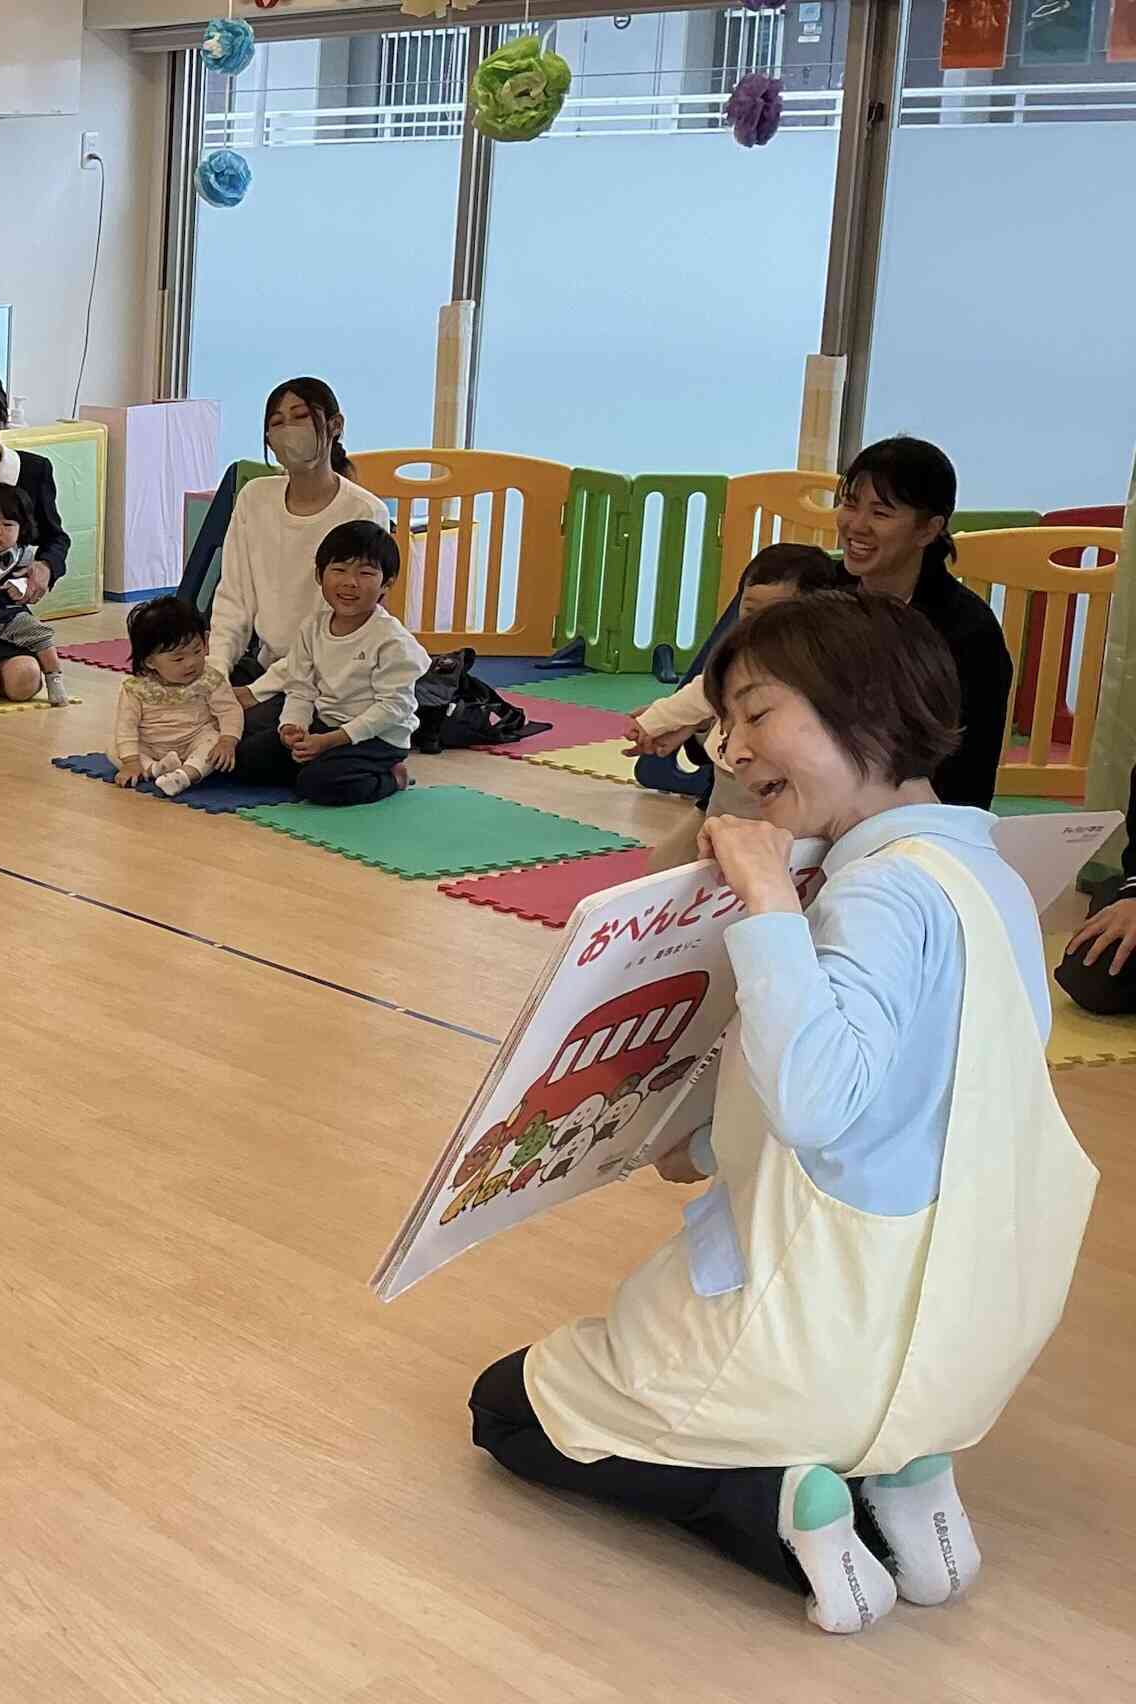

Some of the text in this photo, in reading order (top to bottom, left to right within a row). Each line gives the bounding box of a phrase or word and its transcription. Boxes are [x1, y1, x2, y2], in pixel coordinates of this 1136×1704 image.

[577, 867, 821, 966] おべんとうス
